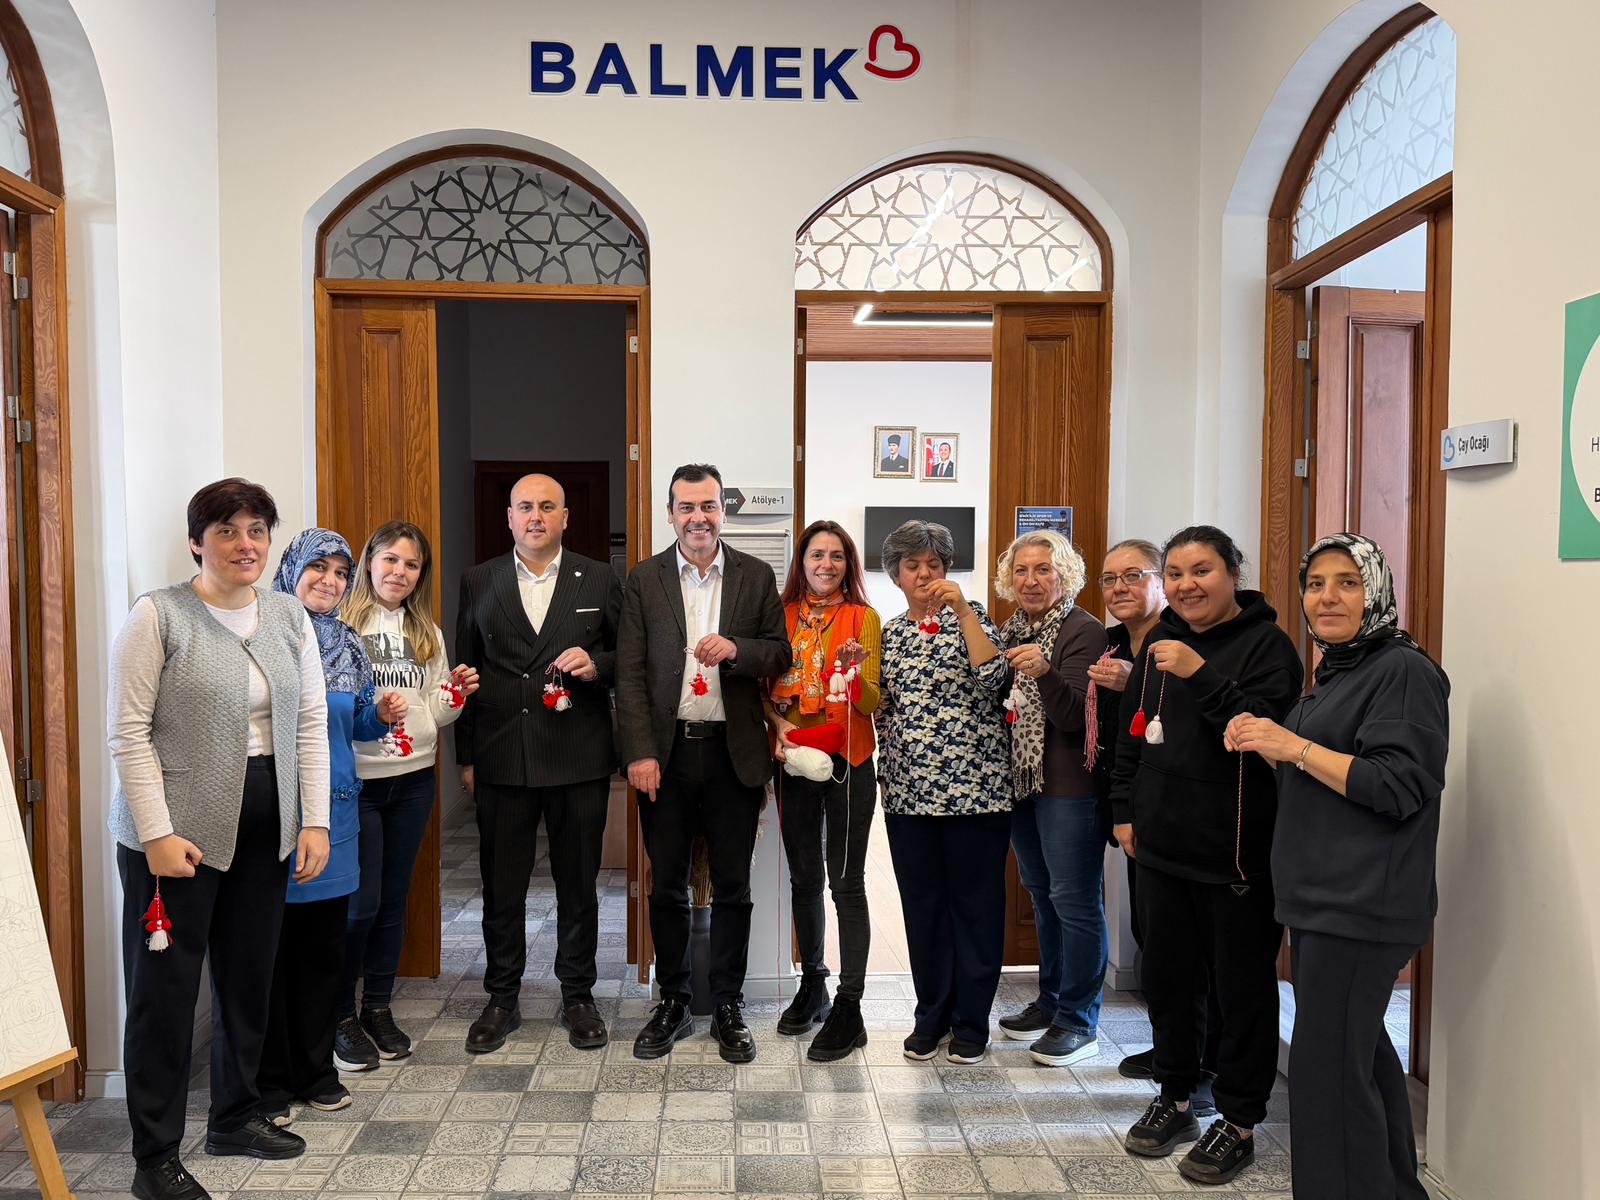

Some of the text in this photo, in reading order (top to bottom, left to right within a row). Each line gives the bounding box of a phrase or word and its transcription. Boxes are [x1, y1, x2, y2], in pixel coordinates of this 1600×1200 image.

[530, 41, 860, 101] BALMEK
[1458, 435, 1489, 455] Çay Ocağı
[1591, 436, 1600, 453] H
[751, 495, 785, 506] Atölye-1
